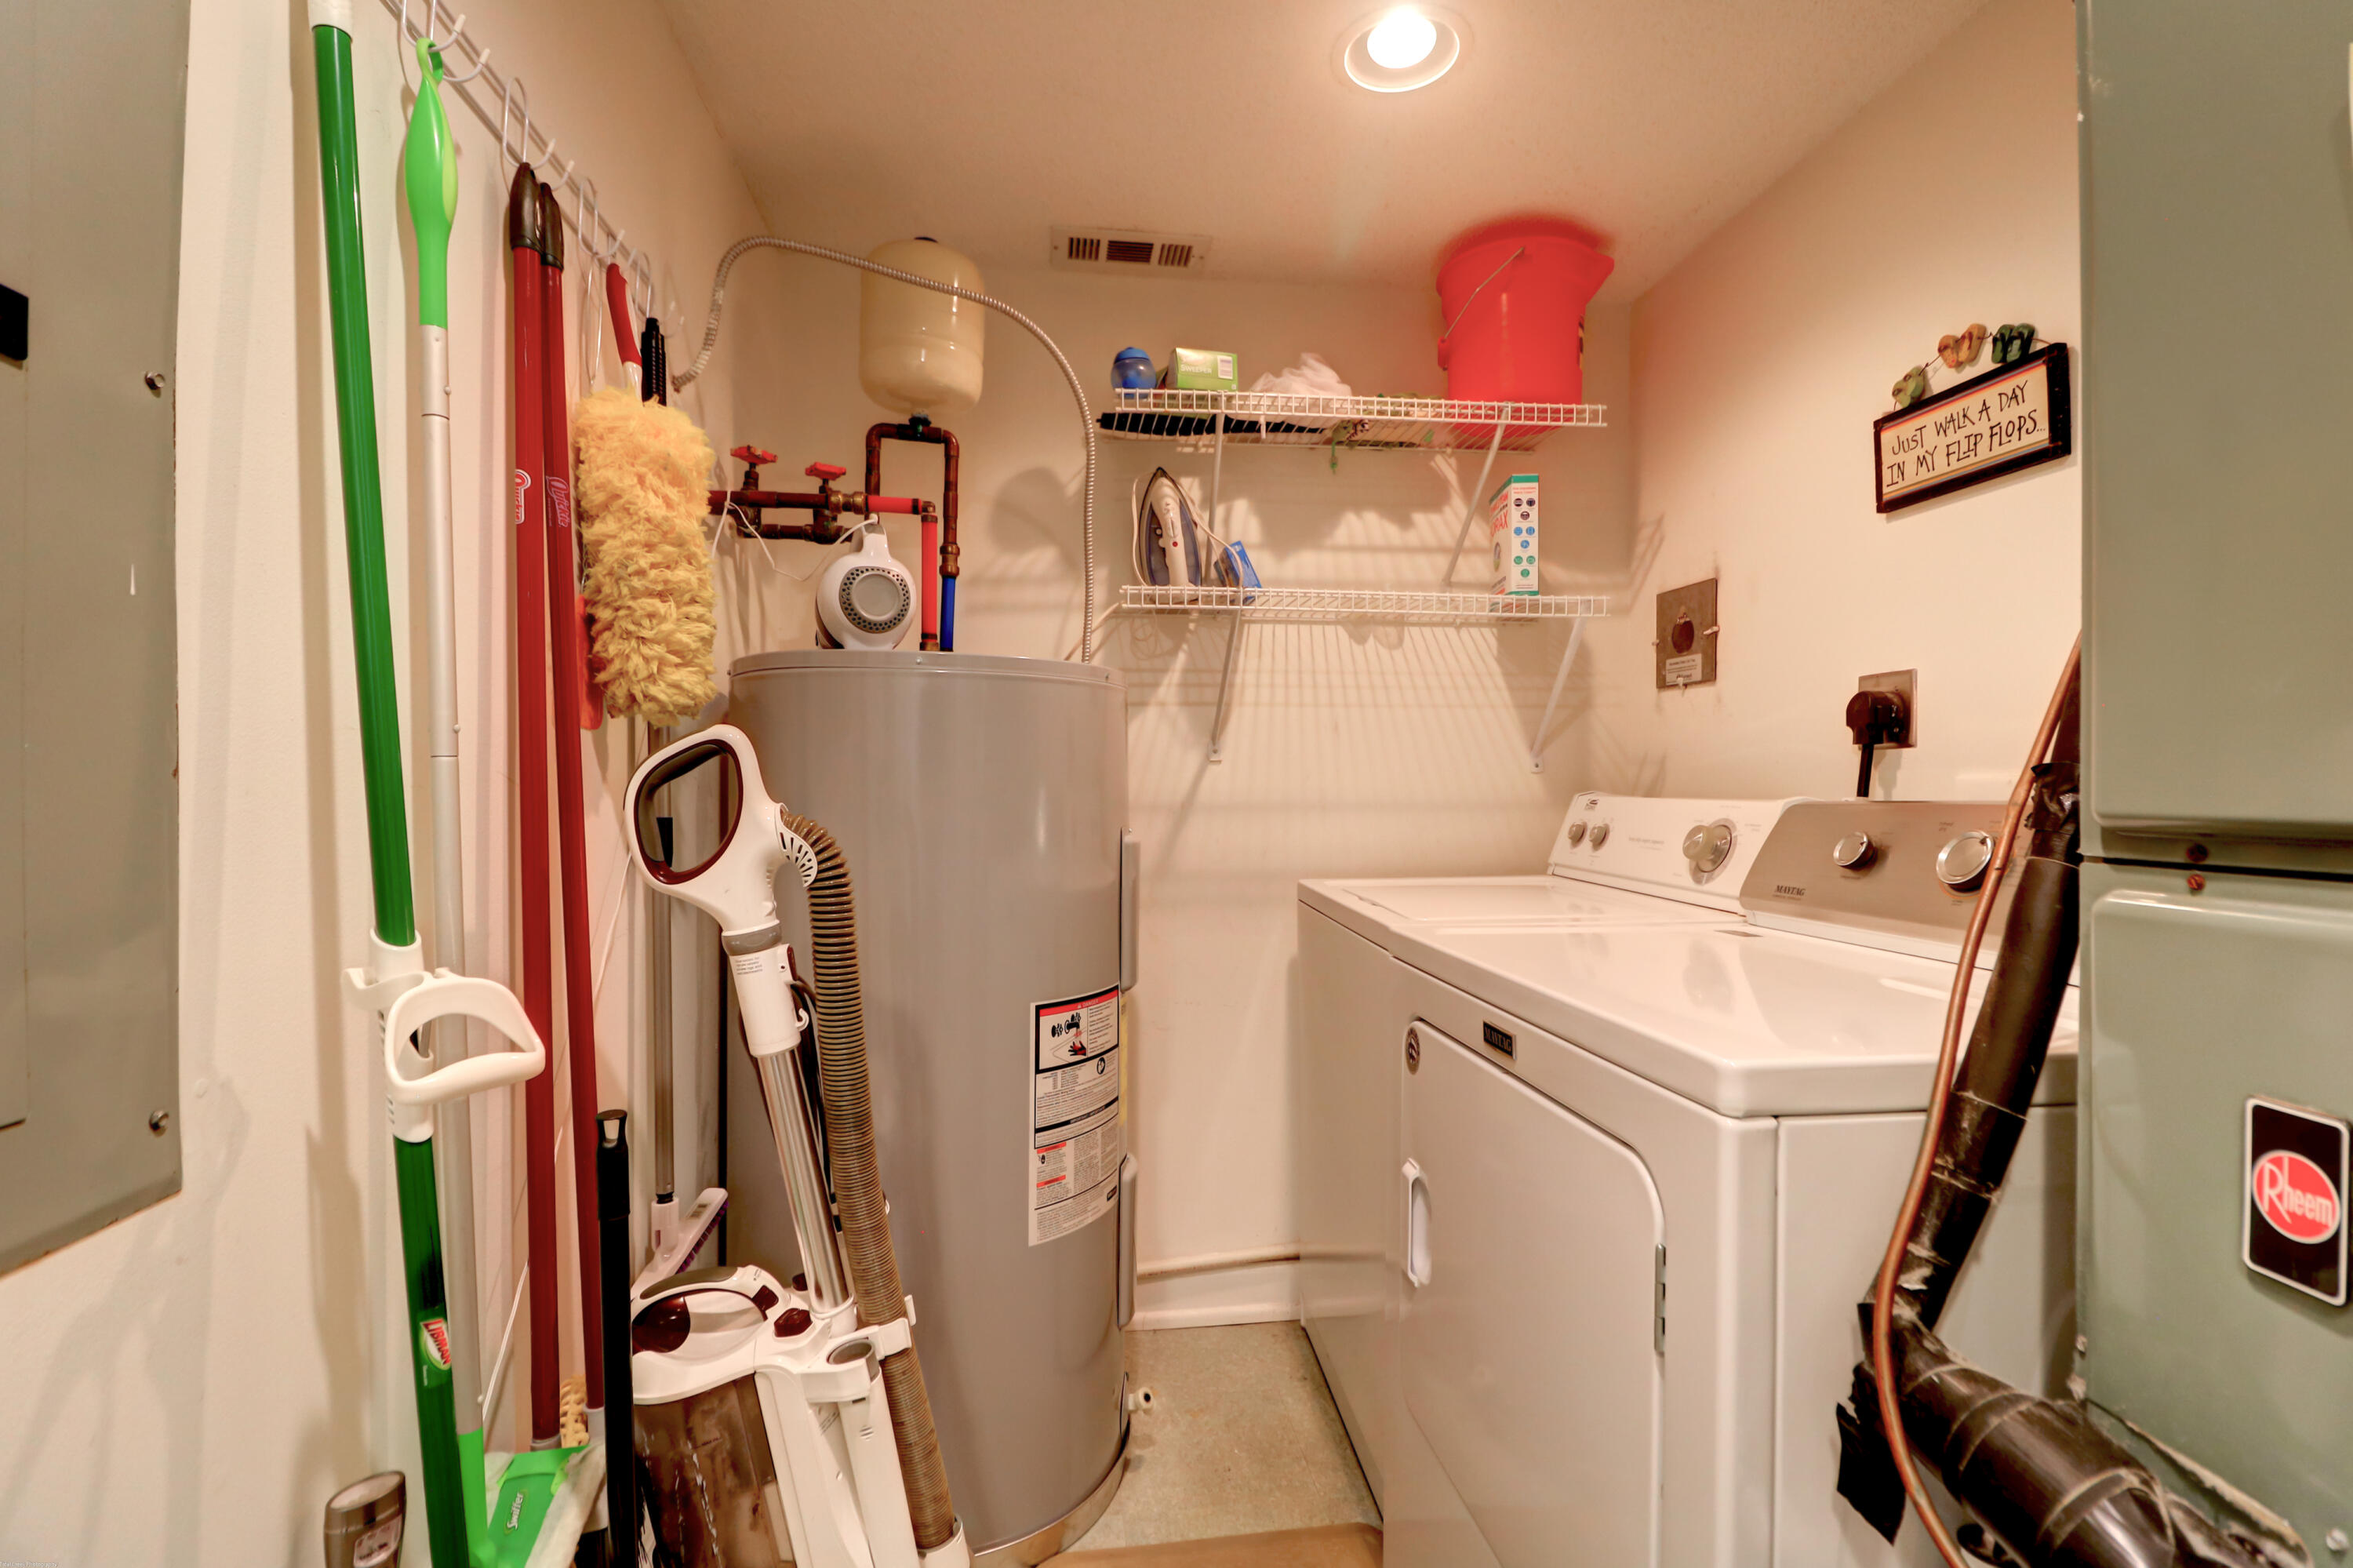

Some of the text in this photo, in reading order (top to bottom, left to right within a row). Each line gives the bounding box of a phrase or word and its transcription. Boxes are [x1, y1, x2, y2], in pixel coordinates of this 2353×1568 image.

[1892, 380, 2028, 456] JUST WALK A DAY
[1886, 461, 1905, 488] IN
[1915, 446, 1937, 476] MY
[1946, 433, 1984, 467] FLIP
[545, 475, 570, 528] Quickie
[1776, 885, 1806, 897] MAYTAG
[1484, 1026, 1512, 1052] MAYTAG
[2262, 1155, 2334, 1227] Rheem
[422, 1318, 452, 1366] LIBMAN
[507, 1492, 524, 1530] Swiffer
